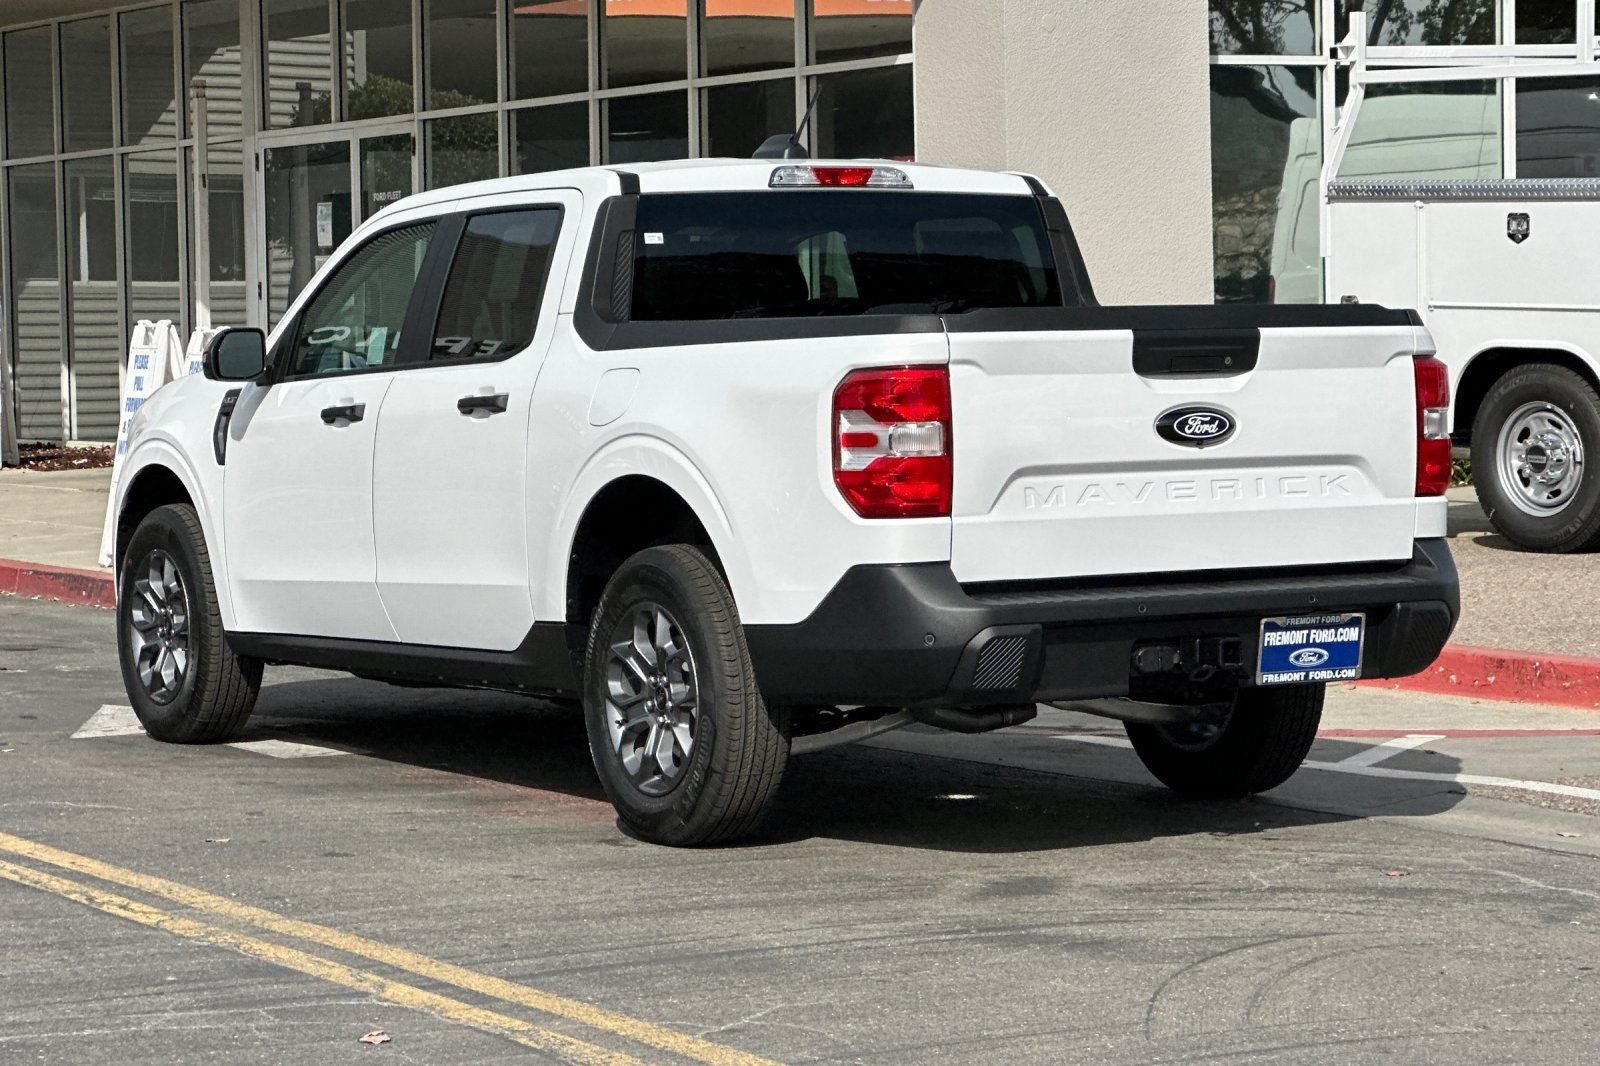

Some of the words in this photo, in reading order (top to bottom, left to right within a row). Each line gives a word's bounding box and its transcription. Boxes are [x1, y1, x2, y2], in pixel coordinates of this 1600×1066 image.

[134, 354, 149, 370] PLEASE
[189, 361, 204, 375] PLEAS
[134, 376, 144, 391] PULL
[1184, 414, 1219, 434] Ford
[1024, 474, 1352, 509] MAVERICK
[1286, 616, 1321, 626] FREMONT
[1321, 615, 1341, 624] FORD
[1264, 630, 1309, 647] FREMONT
[1310, 627, 1359, 644] FORD.COM
[1299, 652, 1318, 662] Ford
[1262, 673, 1306, 683] FREMONT
[1309, 669, 1356, 680] FORD.COM
